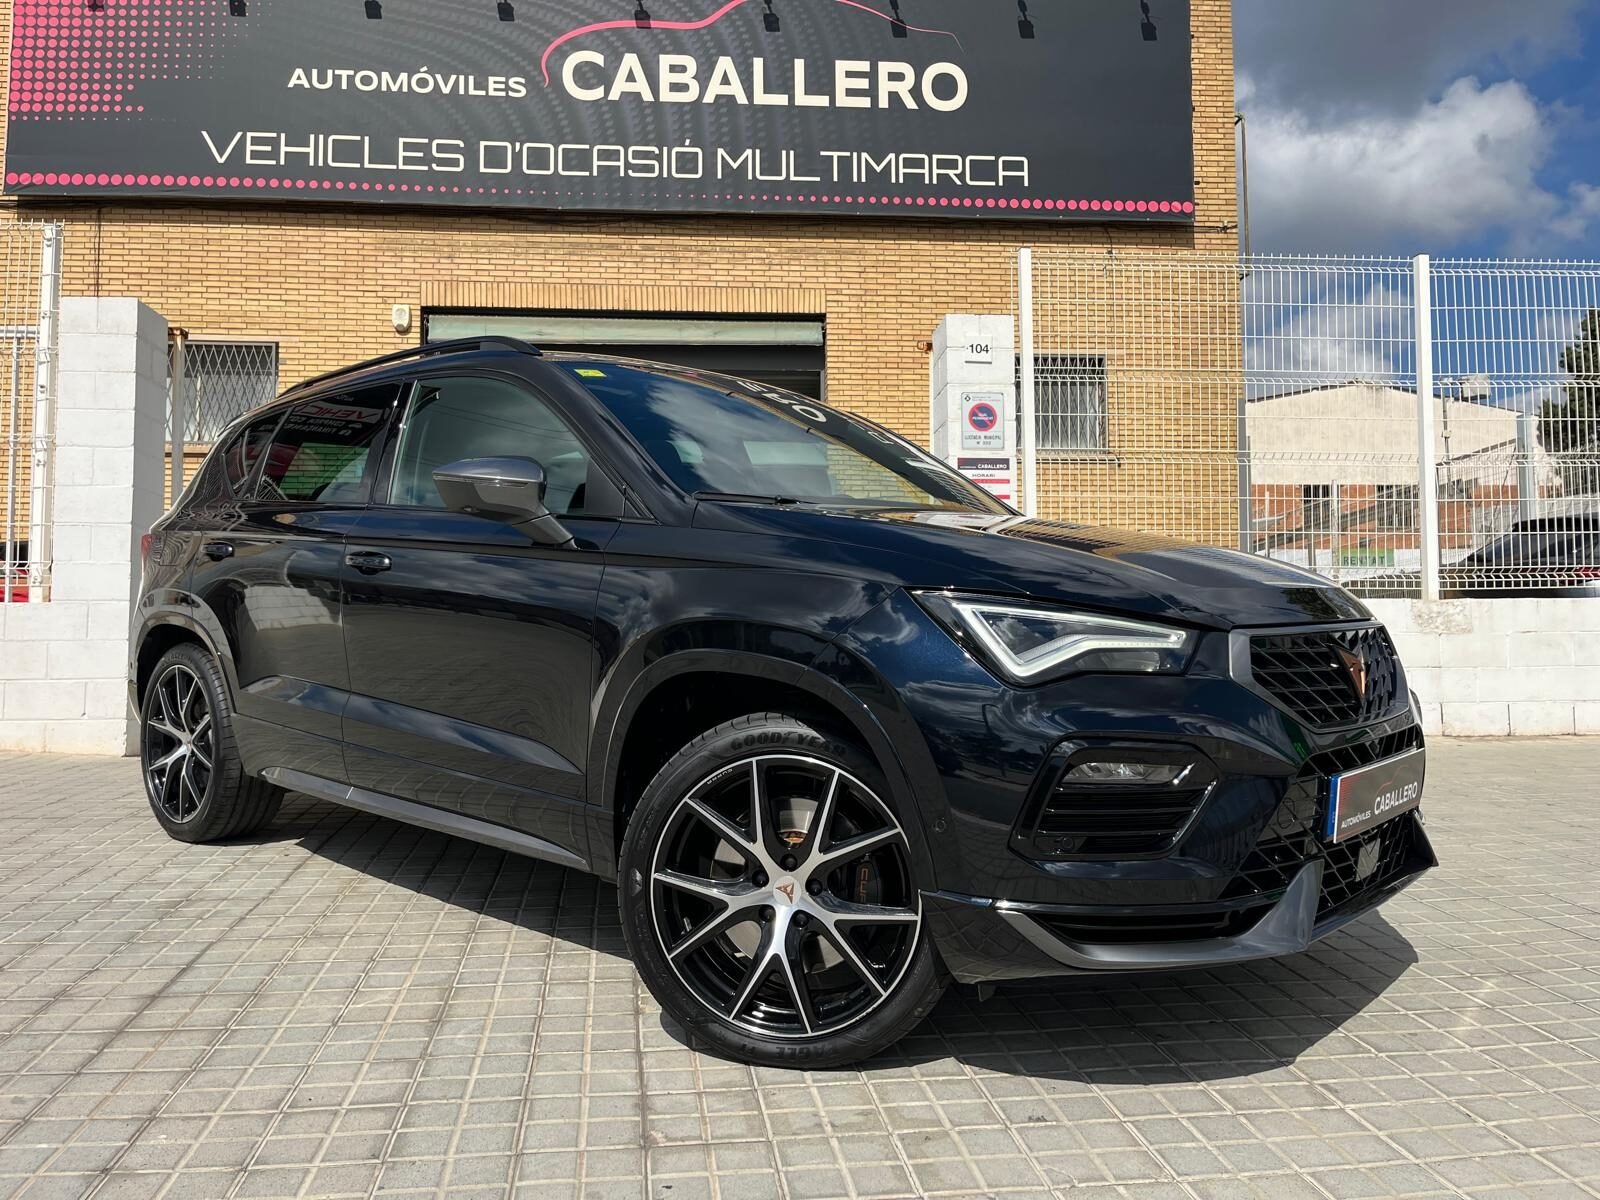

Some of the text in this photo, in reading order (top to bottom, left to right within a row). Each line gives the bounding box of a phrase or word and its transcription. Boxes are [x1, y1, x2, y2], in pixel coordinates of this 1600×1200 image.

[287, 50, 969, 113] AUTOMÓVILES CABALLERO
[200, 129, 1030, 188] VEHICLES D'OCASIÓ MULTIMARCA
[969, 343, 990, 354] 104
[1374, 781, 1418, 815] CABALLERO
